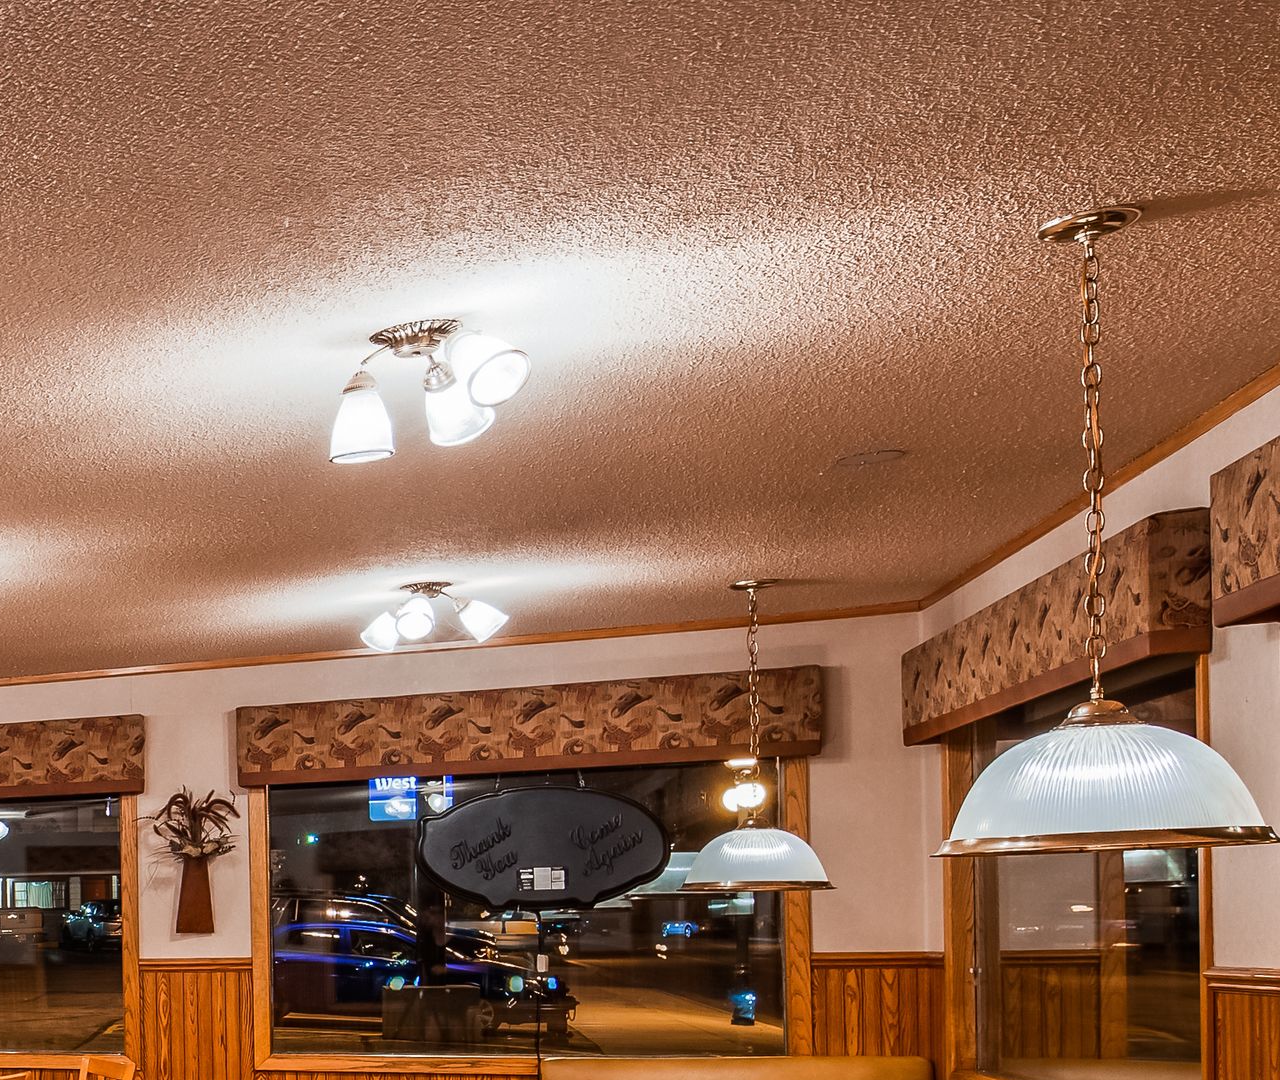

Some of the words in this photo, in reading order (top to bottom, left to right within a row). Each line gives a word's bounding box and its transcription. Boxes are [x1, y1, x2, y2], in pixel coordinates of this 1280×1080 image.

[450, 816, 512, 871] Thank
[569, 812, 624, 851] Come
[583, 829, 644, 877] Again
[475, 851, 519, 881] You
